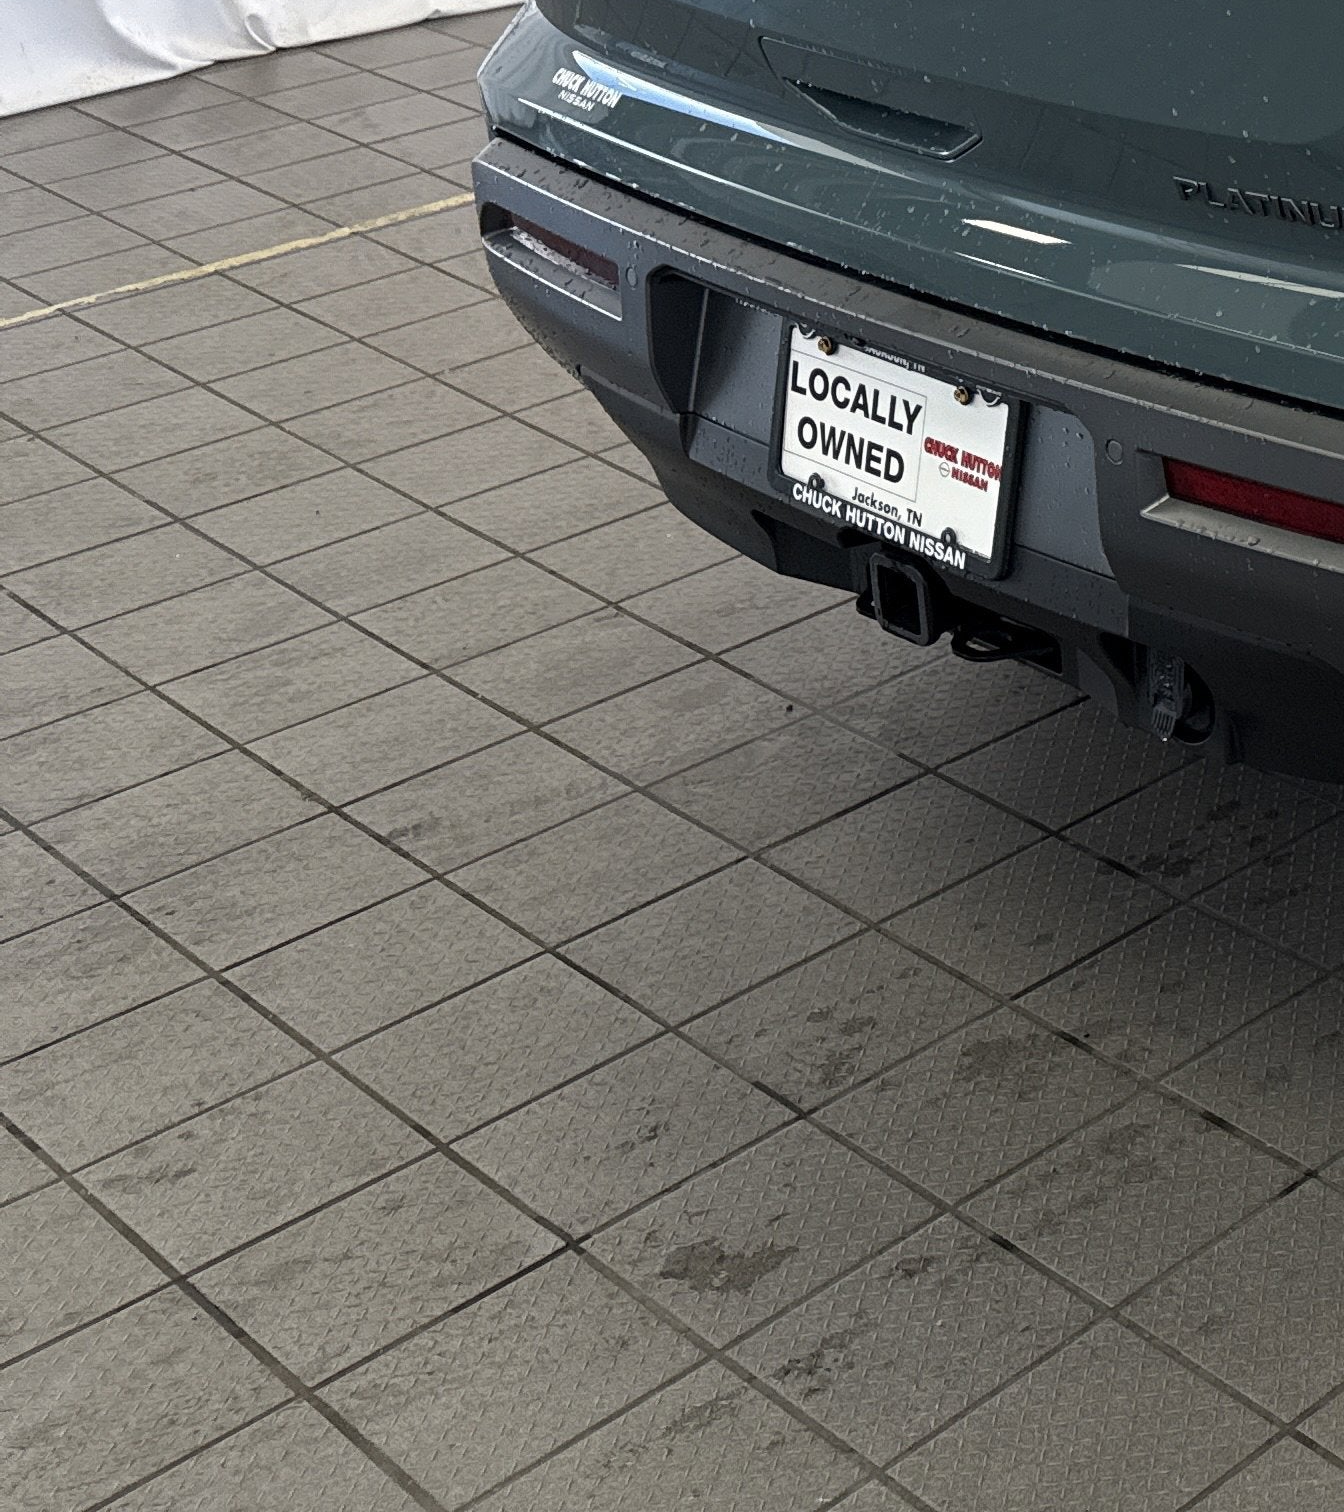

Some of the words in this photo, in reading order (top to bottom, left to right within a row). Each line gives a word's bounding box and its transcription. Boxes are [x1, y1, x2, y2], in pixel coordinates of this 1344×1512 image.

[557, 89, 596, 112] NISSAN
[790, 360, 923, 436] LOCALLY
[797, 416, 905, 484] OWNED
[924, 436, 959, 464] CHUCK
[961, 450, 1002, 482] HUTTON
[951, 466, 988, 493] NISSAN
[791, 482, 842, 519] CHUCK
[845, 503, 906, 545] HUTTON
[909, 532, 967, 570] NISSAN
[851, 487, 903, 521] Jackson,
[906, 507, 923, 528] TN
